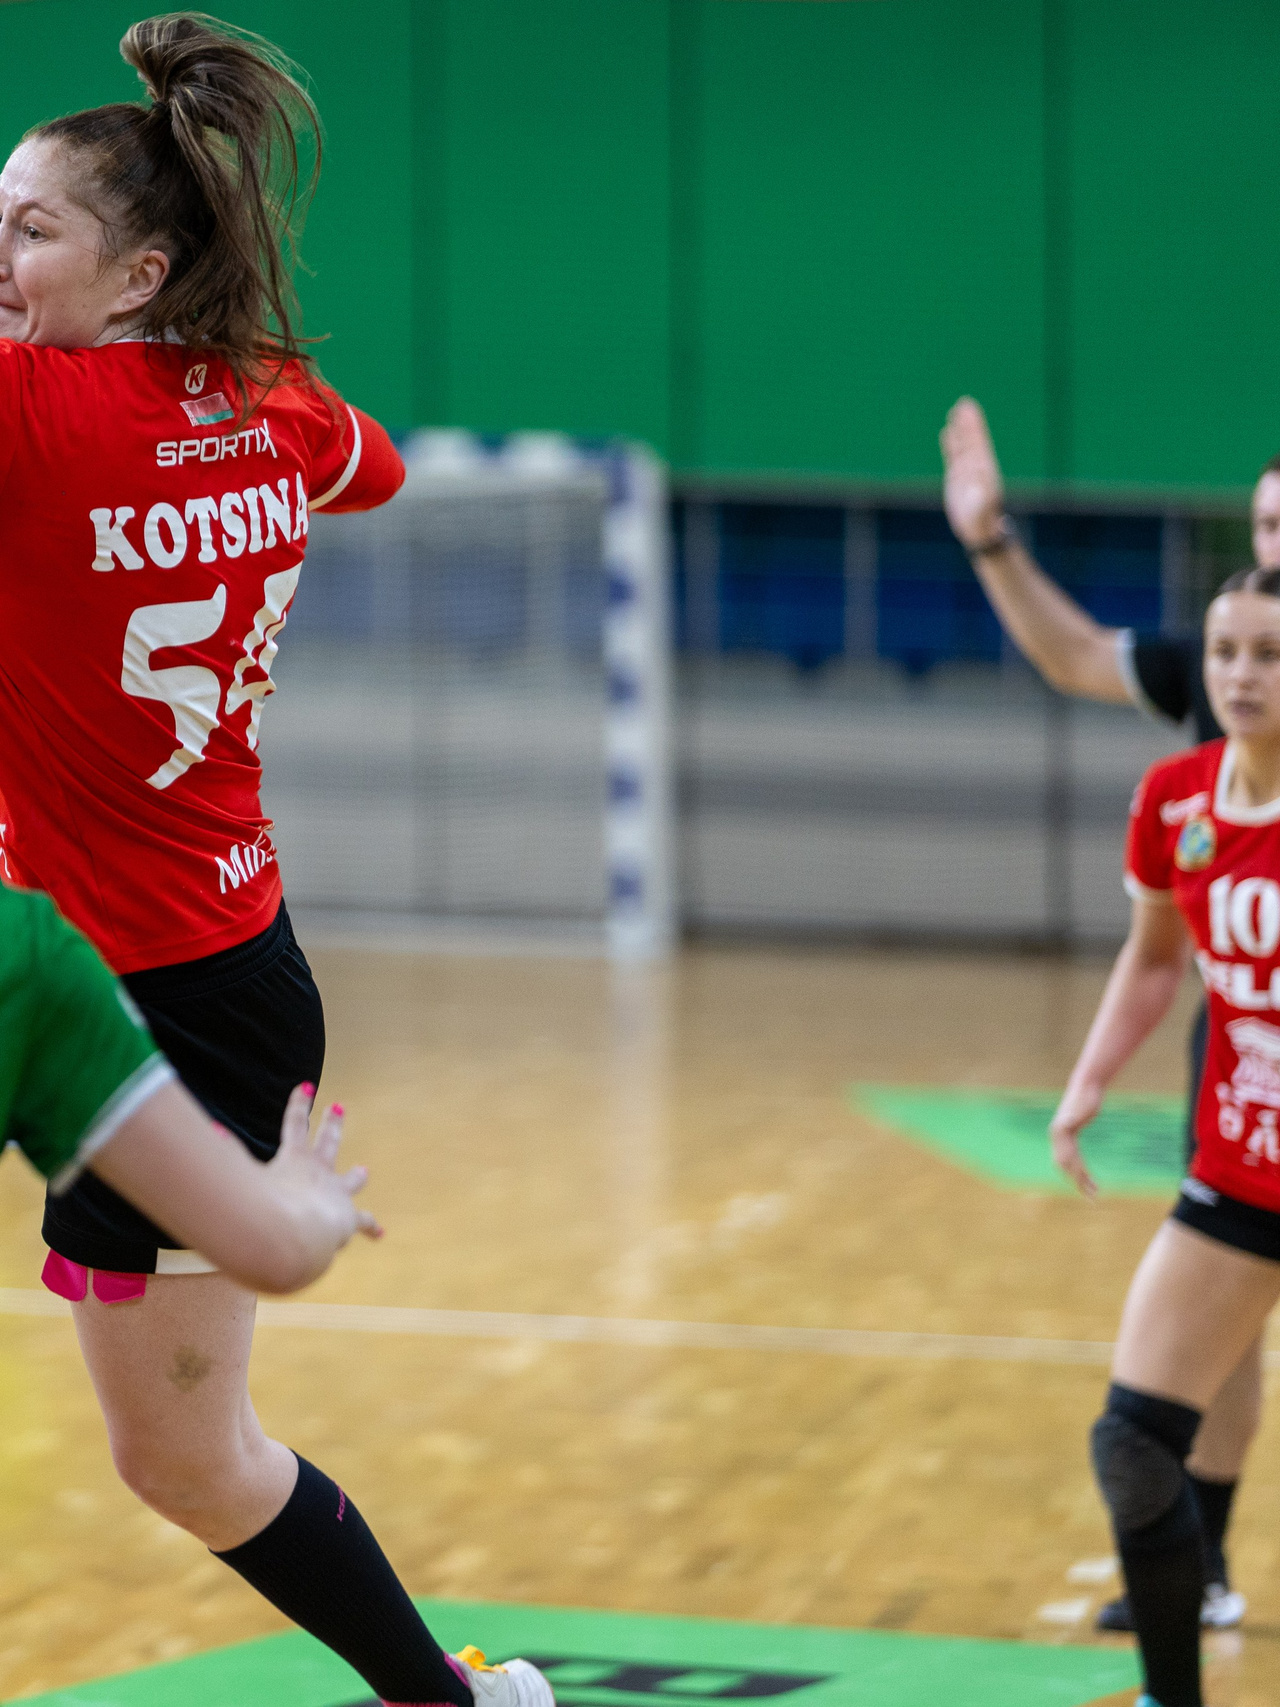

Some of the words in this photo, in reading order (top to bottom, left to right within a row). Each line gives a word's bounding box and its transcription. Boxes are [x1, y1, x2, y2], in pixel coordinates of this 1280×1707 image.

[156, 418, 278, 467] SPORTIX
[89, 472, 309, 572] KOTSINA
[121, 561, 303, 790] 54
[1208, 873, 1280, 959] 10
